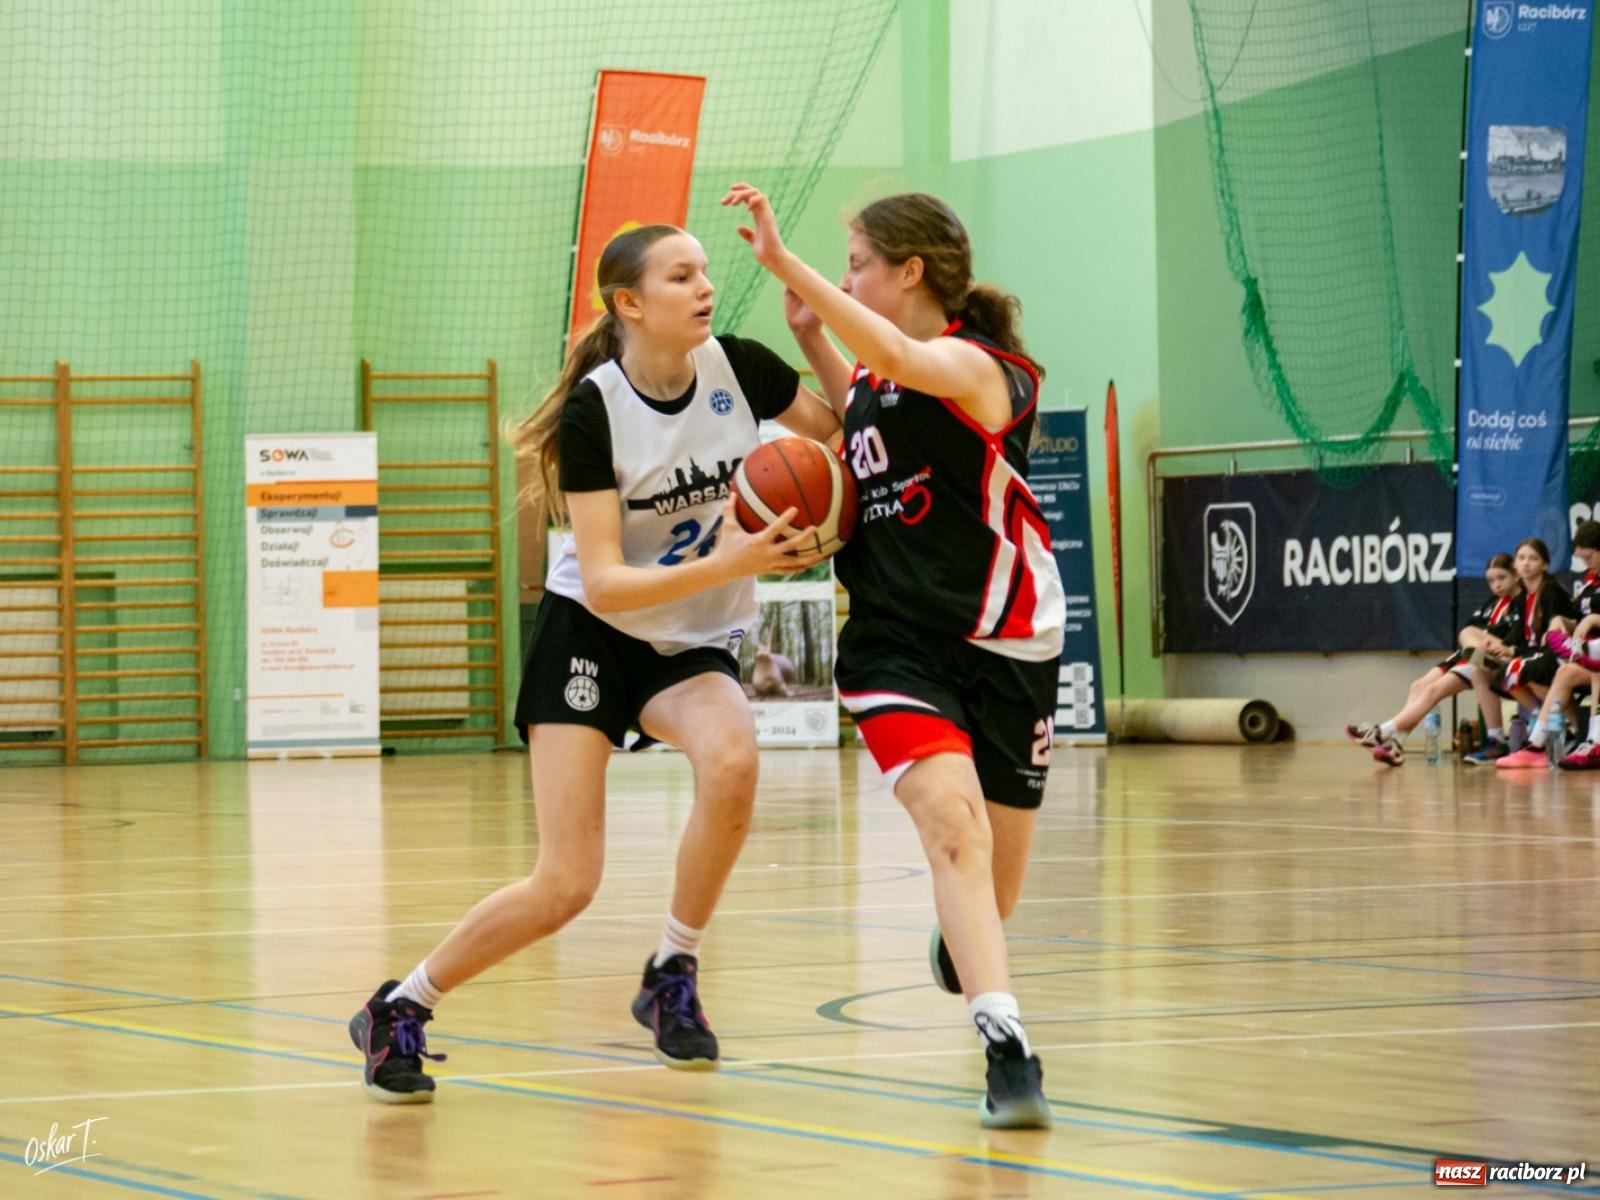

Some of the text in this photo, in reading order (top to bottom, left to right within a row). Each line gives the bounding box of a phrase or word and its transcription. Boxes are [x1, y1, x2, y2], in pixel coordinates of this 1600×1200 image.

[1518, 4, 1587, 20] Racibórz
[1468, 409, 1547, 432] Dodaj coś
[259, 448, 309, 463] SOWA
[851, 425, 889, 480] 20
[1283, 515, 1457, 587] RACIBÓRZ
[570, 656, 599, 678] NW
